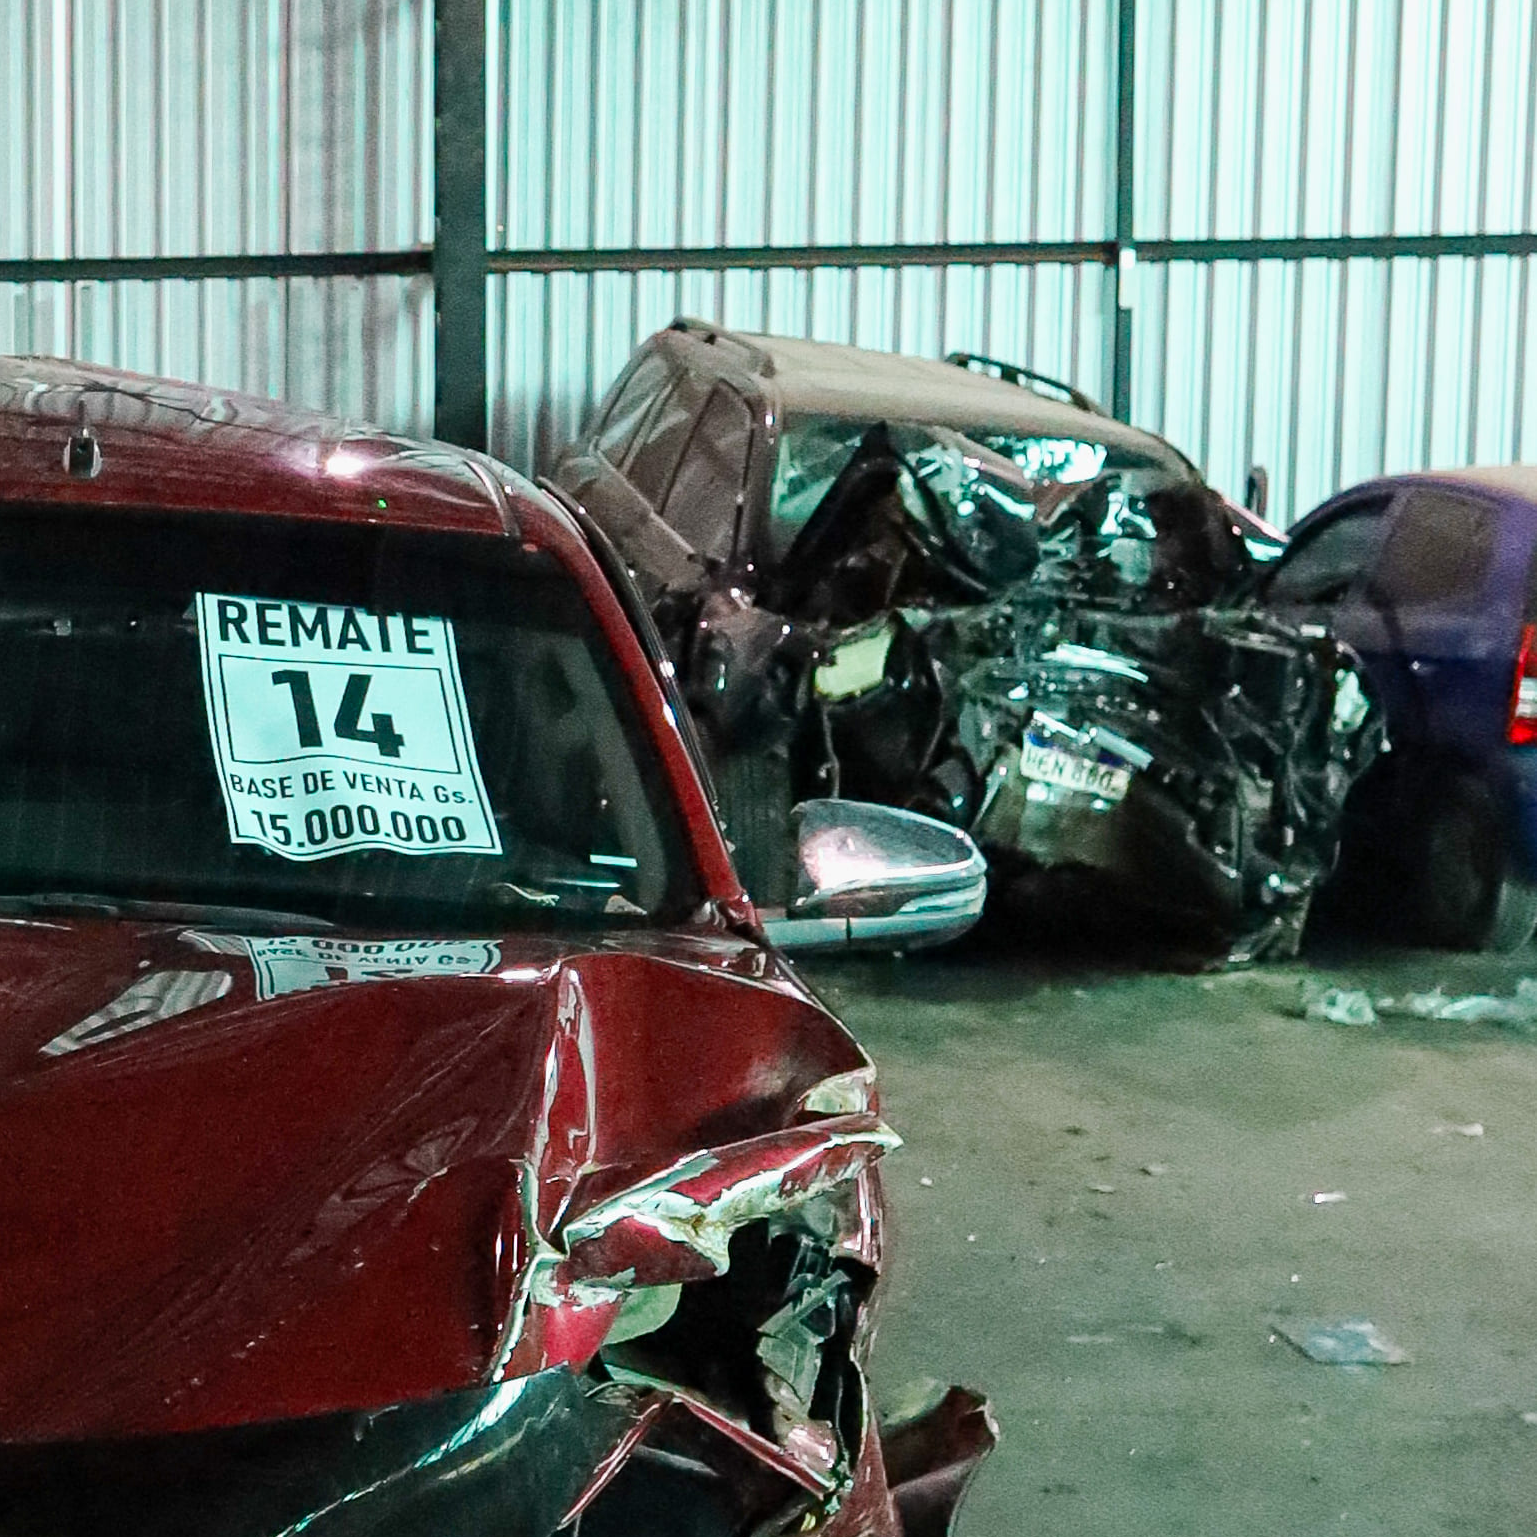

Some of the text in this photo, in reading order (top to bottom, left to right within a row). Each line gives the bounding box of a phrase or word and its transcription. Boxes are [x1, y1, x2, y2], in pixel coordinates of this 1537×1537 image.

[217, 600, 434, 655] REMATE
[272, 669, 405, 758] 14
[230, 771, 475, 805] BASE DE VENTA Gs.
[251, 804, 466, 848] 15.000.000
